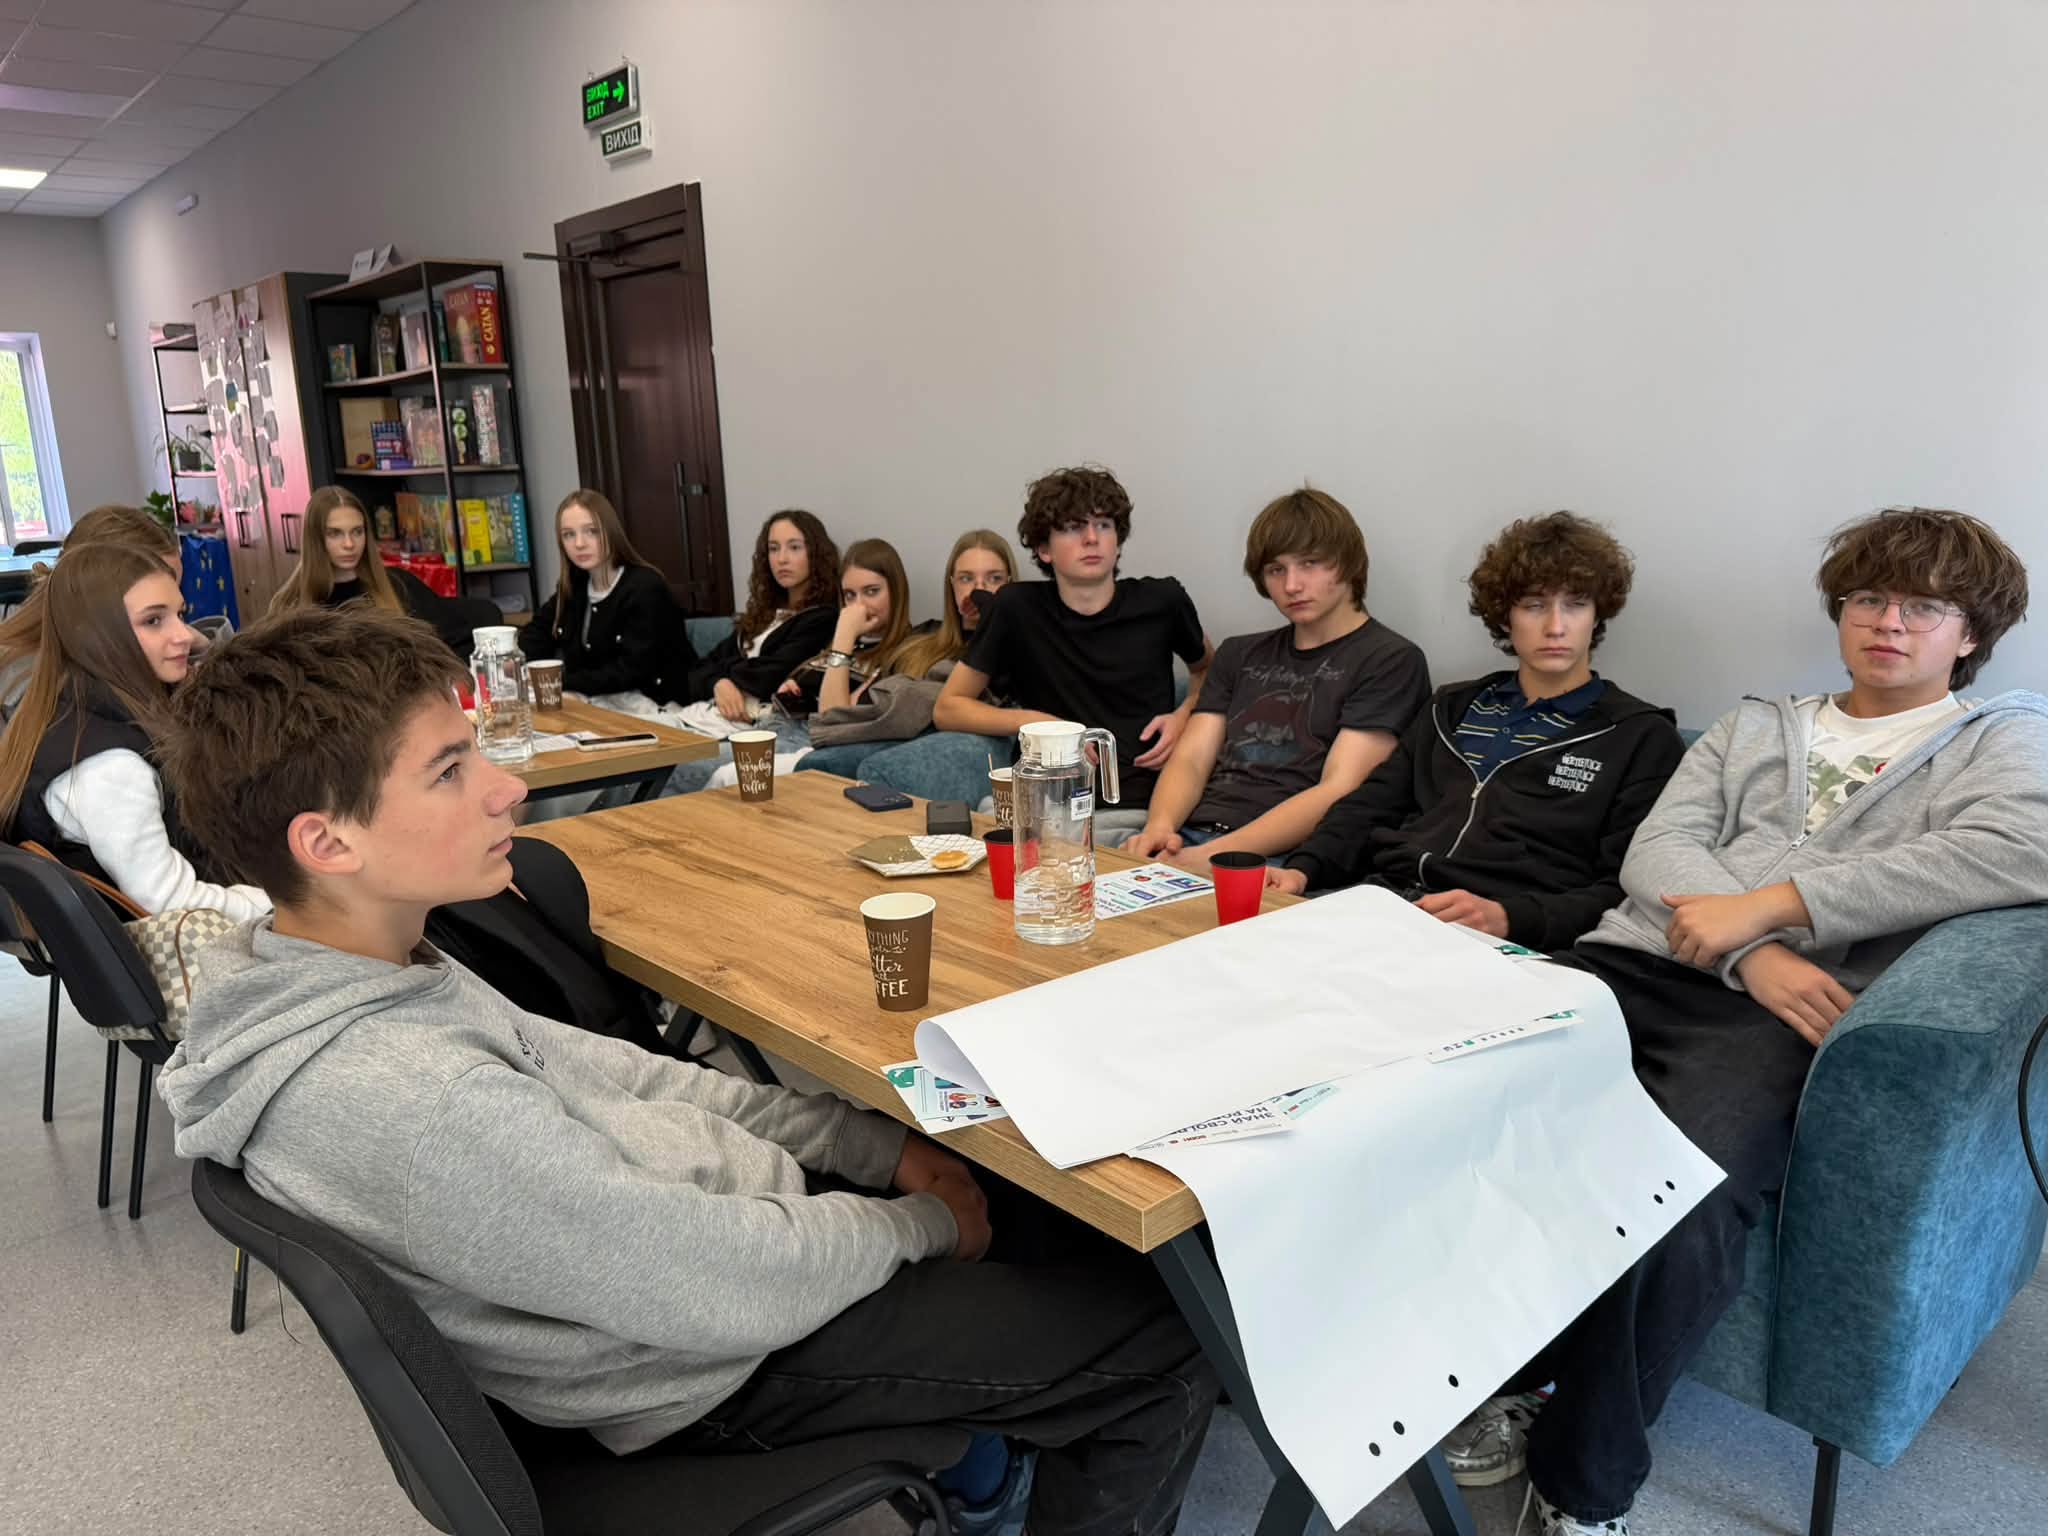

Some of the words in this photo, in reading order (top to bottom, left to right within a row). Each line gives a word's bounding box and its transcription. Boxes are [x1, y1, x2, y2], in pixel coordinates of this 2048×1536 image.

[586, 81, 609, 102] ВИХІД
[587, 100, 605, 120] EXIT
[606, 125, 639, 152] ВИХІД
[480, 306, 495, 342] CATAN
[1231, 1112, 1275, 1125] ЗНАЙ
[1246, 1106, 1269, 1117] НА
